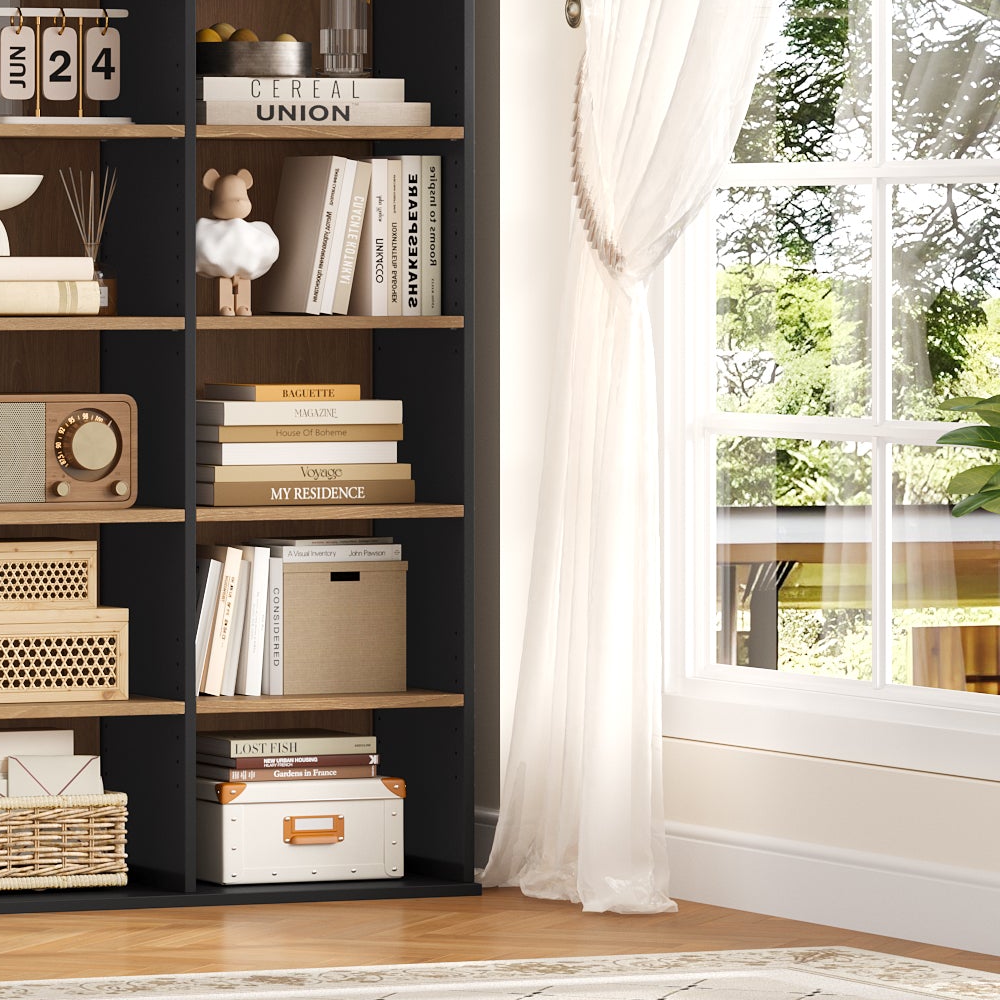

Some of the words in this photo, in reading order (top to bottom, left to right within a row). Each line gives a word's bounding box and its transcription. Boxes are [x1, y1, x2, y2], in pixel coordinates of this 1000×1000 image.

[9, 46, 26, 89] JUN
[49, 49, 72, 83] 2
[91, 47, 116, 80] 4
[251, 79, 360, 99] CEREAL
[256, 104, 350, 122] UNION
[282, 389, 335, 398] BAGUETTE
[294, 408, 338, 419] MAGAZINE
[275, 428, 301, 437] House
[302, 428, 313, 437] Of
[315, 428, 347, 437] Boheme
[300, 466, 343, 481] Voyage
[270, 487, 292, 500] MY
[294, 486, 366, 500] RESIDENCE
[311, 549, 336, 558] Inventory
[349, 549, 363, 557] John
[363, 549, 386, 557] Pawson
[235, 743, 268, 755] LOST
[270, 742, 297, 754] FISH
[273, 768, 302, 778] Gardens
[304, 769, 311, 777] in
[312, 768, 337, 777] France
